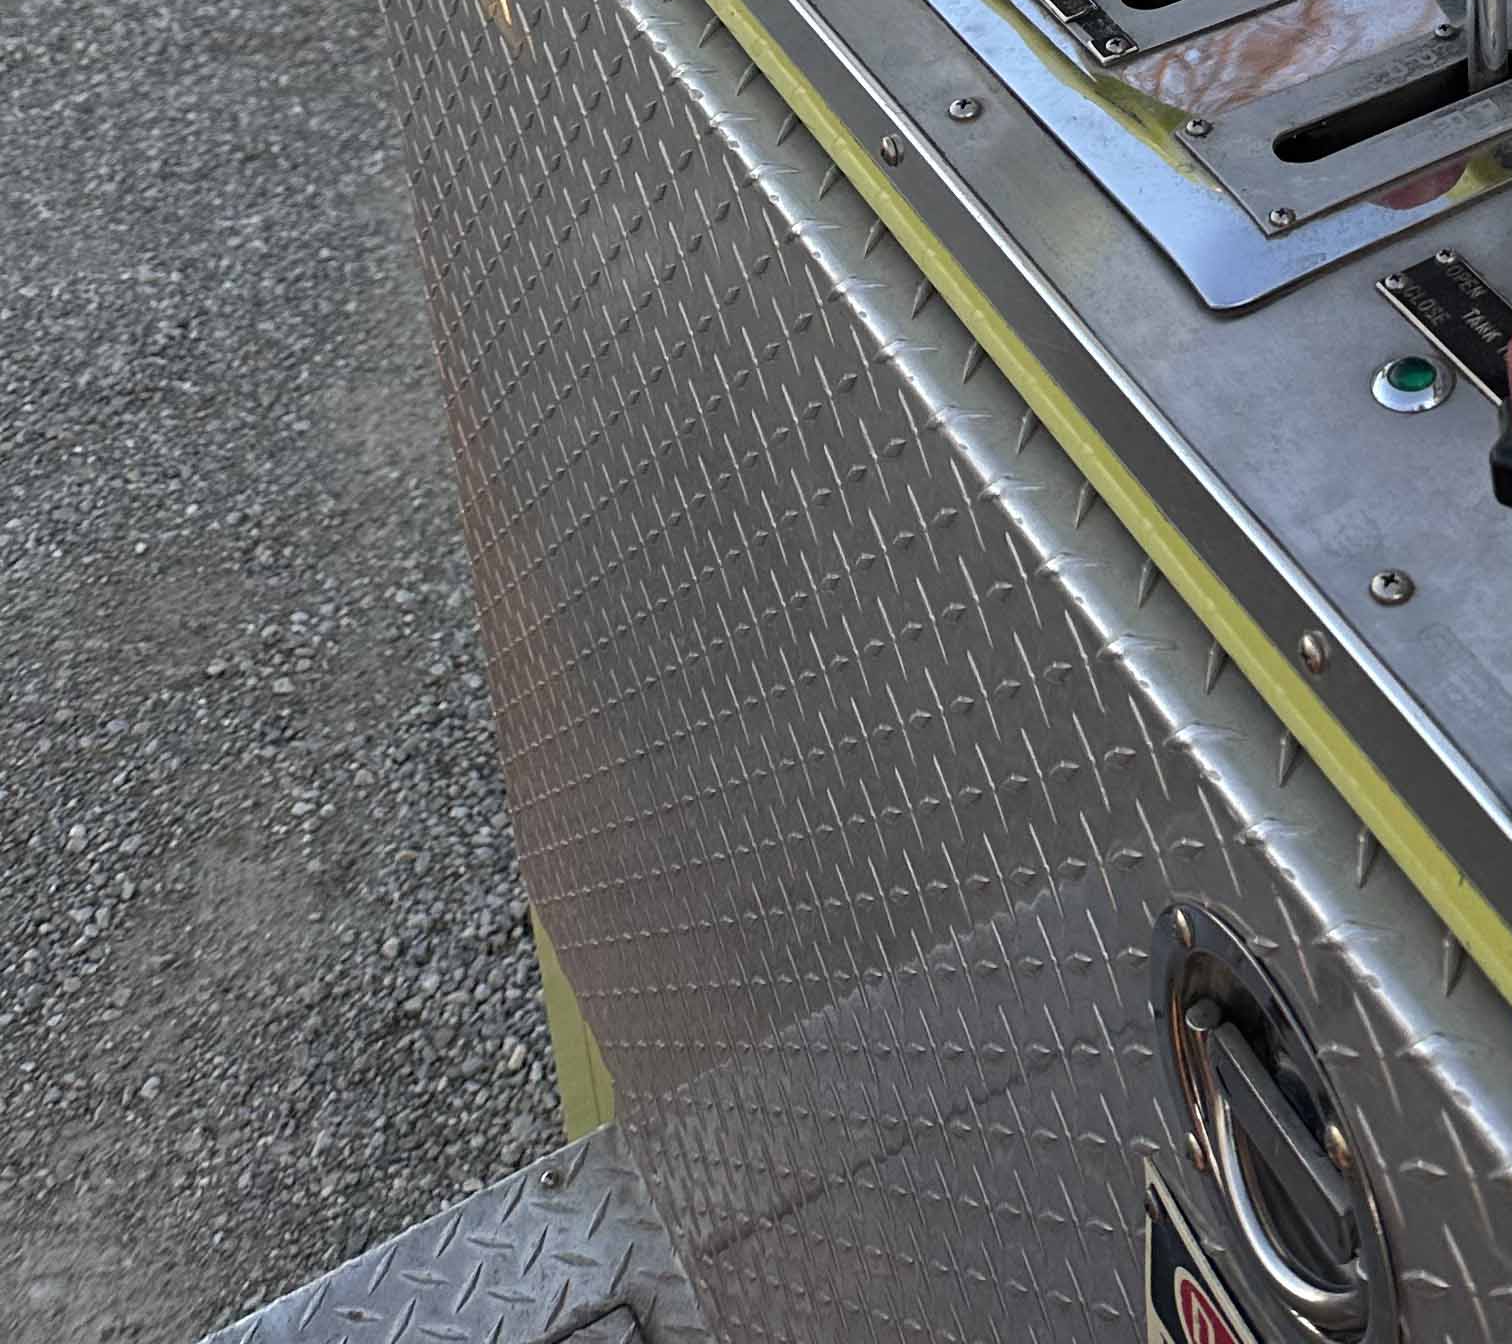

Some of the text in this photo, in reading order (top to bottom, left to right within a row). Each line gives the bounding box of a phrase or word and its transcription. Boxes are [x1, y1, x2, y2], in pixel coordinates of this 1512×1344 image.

[1446, 264, 1488, 298] OPEN
[1403, 285, 1451, 327] CLOSE
[1462, 306, 1503, 343] TANK
